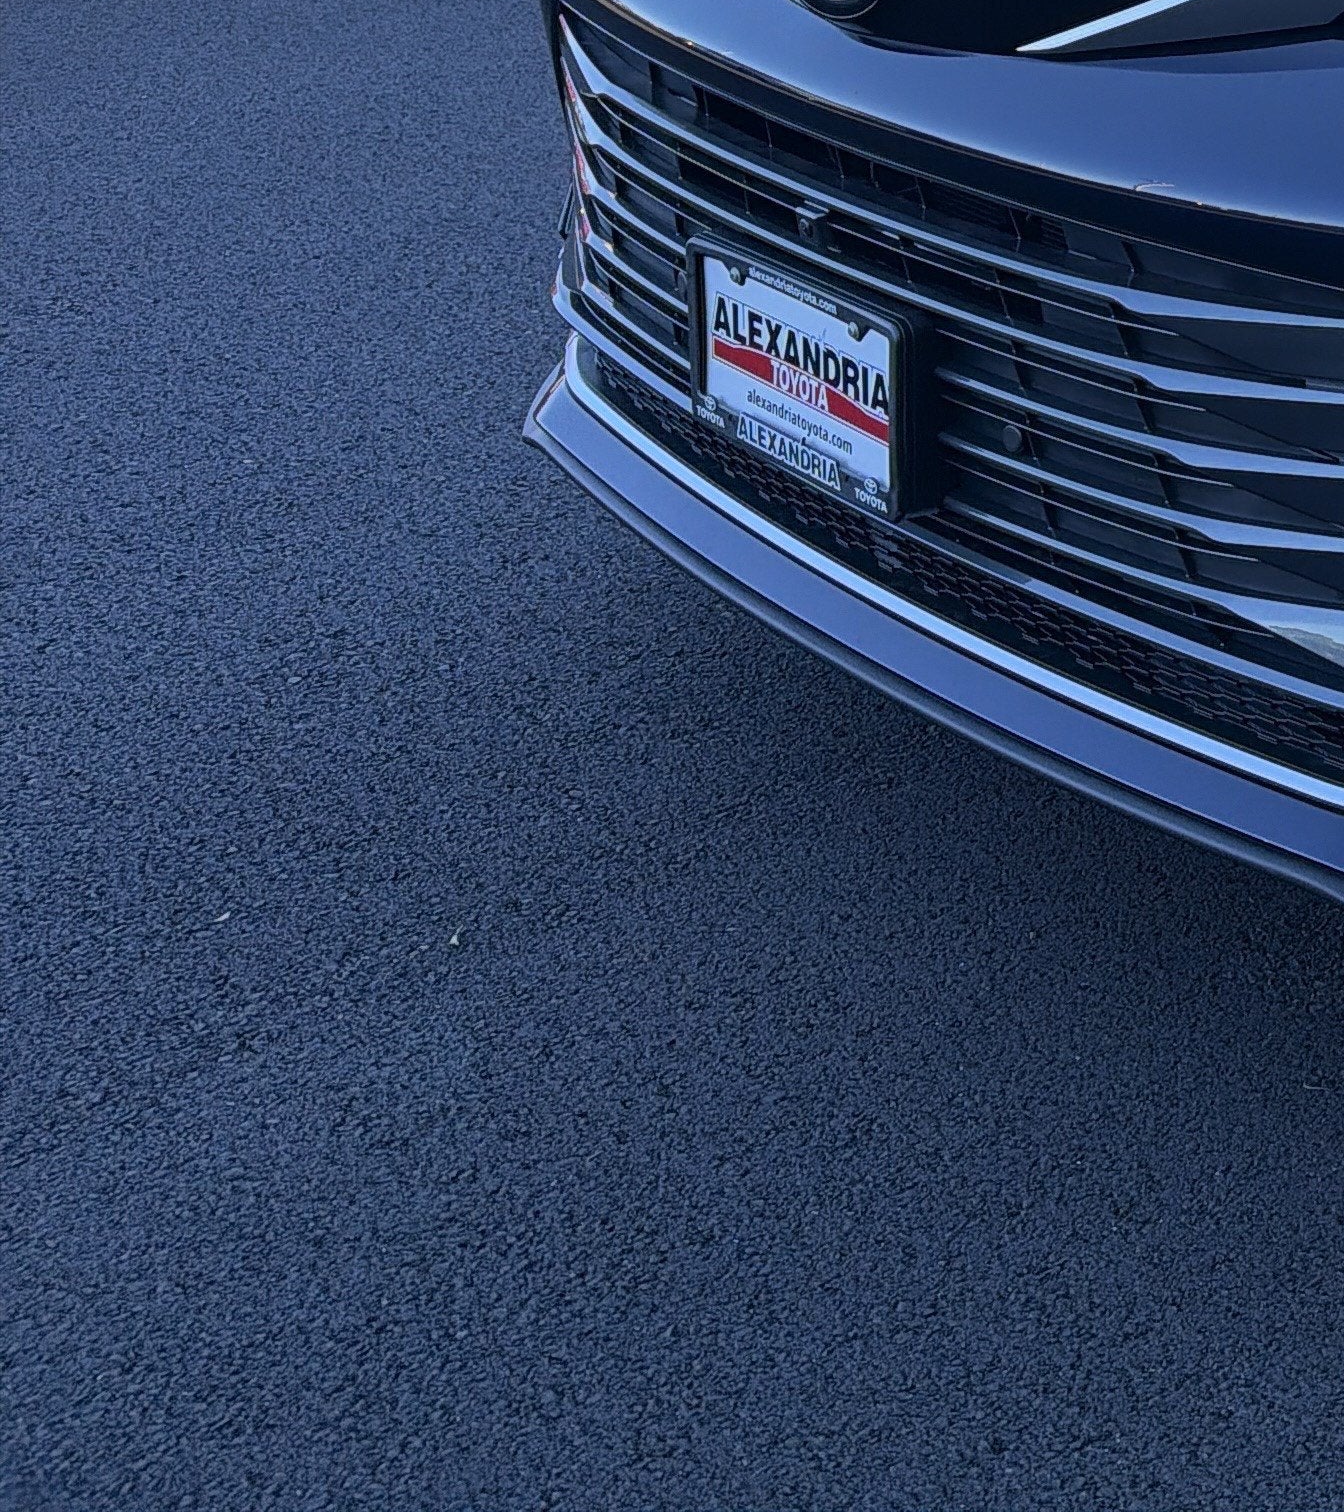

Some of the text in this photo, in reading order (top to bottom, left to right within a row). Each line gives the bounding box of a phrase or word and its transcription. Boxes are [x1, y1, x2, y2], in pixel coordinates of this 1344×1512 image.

[749, 266, 838, 316] alexandriatoyota.com
[713, 295, 889, 417] ALEXANDRIA
[770, 360, 829, 412] TOYOTA
[696, 404, 725, 429] TOYOTA
[747, 389, 853, 455] alexandriatoyota.com
[737, 413, 841, 489] ALEXANDRIA
[854, 487, 888, 514] TOYOTA
